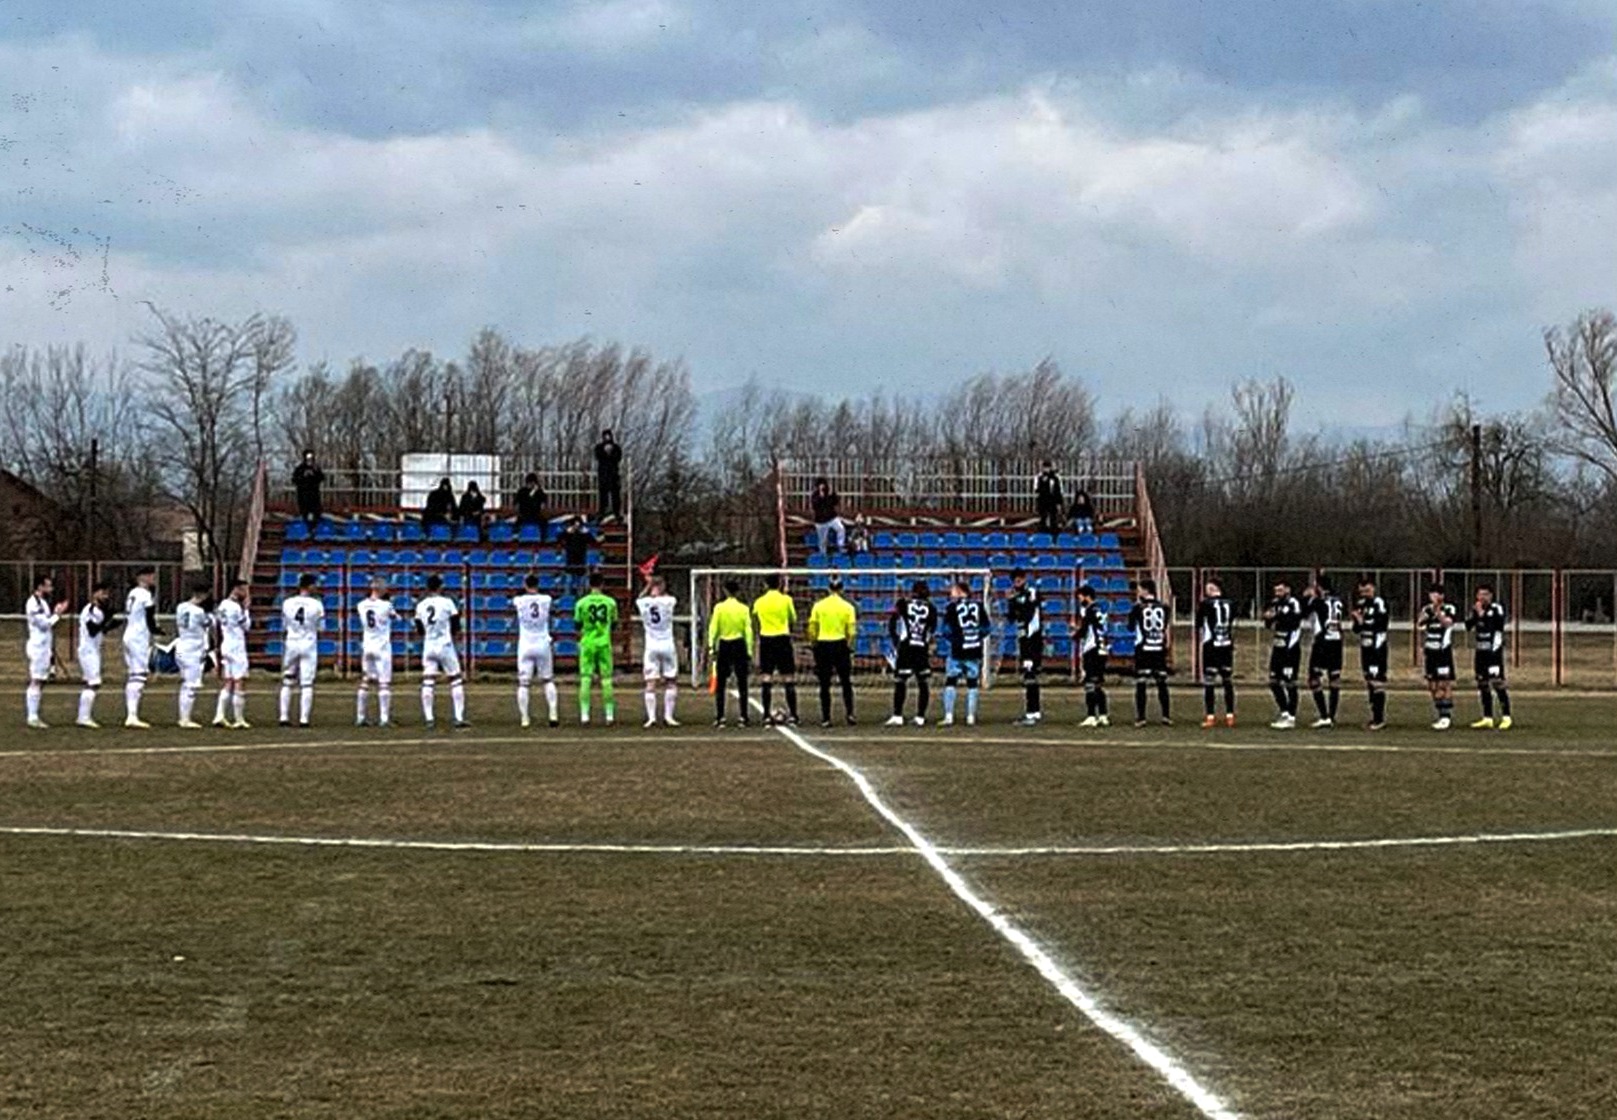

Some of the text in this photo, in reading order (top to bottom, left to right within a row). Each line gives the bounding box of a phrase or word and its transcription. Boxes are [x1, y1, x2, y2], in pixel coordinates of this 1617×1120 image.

[294, 606, 305, 625] 4
[366, 609, 376, 628] 6
[426, 605, 436, 625] 2
[529, 602, 539, 618] 3
[588, 603, 607, 624] 33
[649, 606, 661, 624] 5
[956, 603, 978, 627] 23
[1214, 600, 1230, 626] 11
